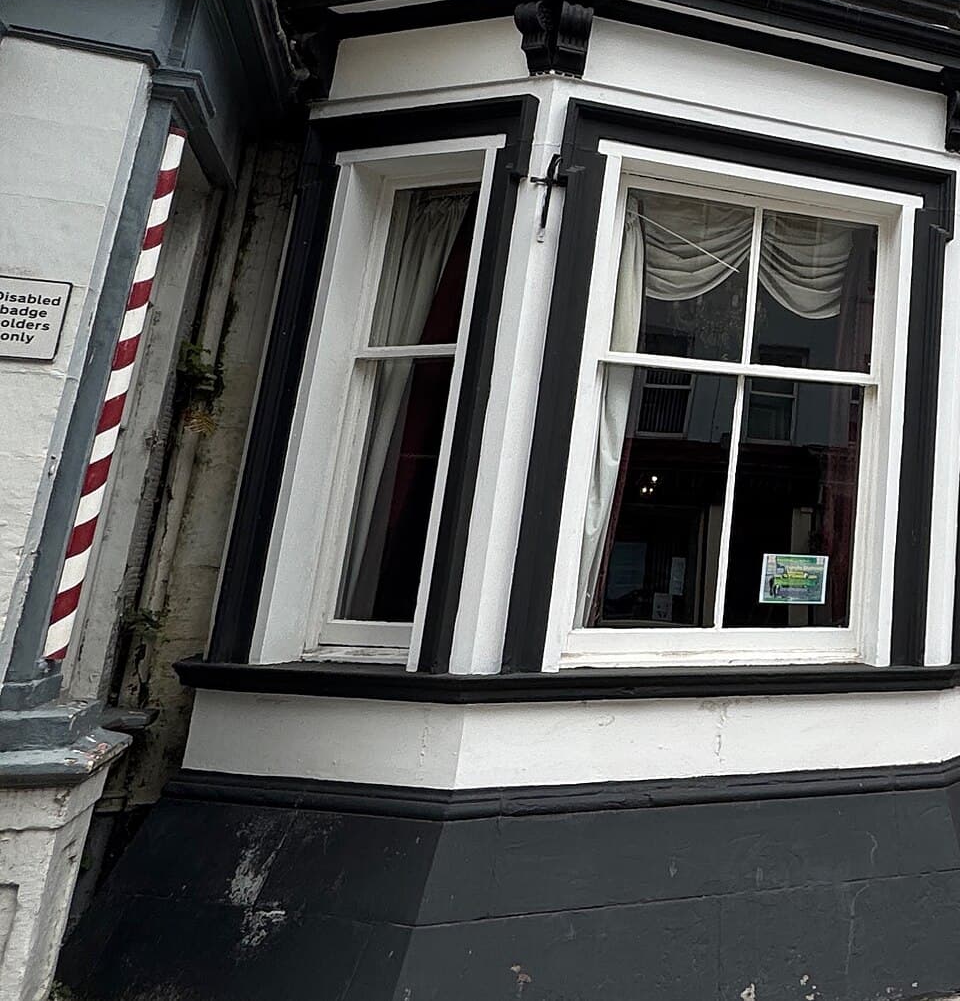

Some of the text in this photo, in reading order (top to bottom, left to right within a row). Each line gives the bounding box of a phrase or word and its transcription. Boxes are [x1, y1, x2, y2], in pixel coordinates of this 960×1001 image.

[0, 304, 47, 319] badge
[0, 319, 50, 331] olders
[0, 332, 34, 344] only
